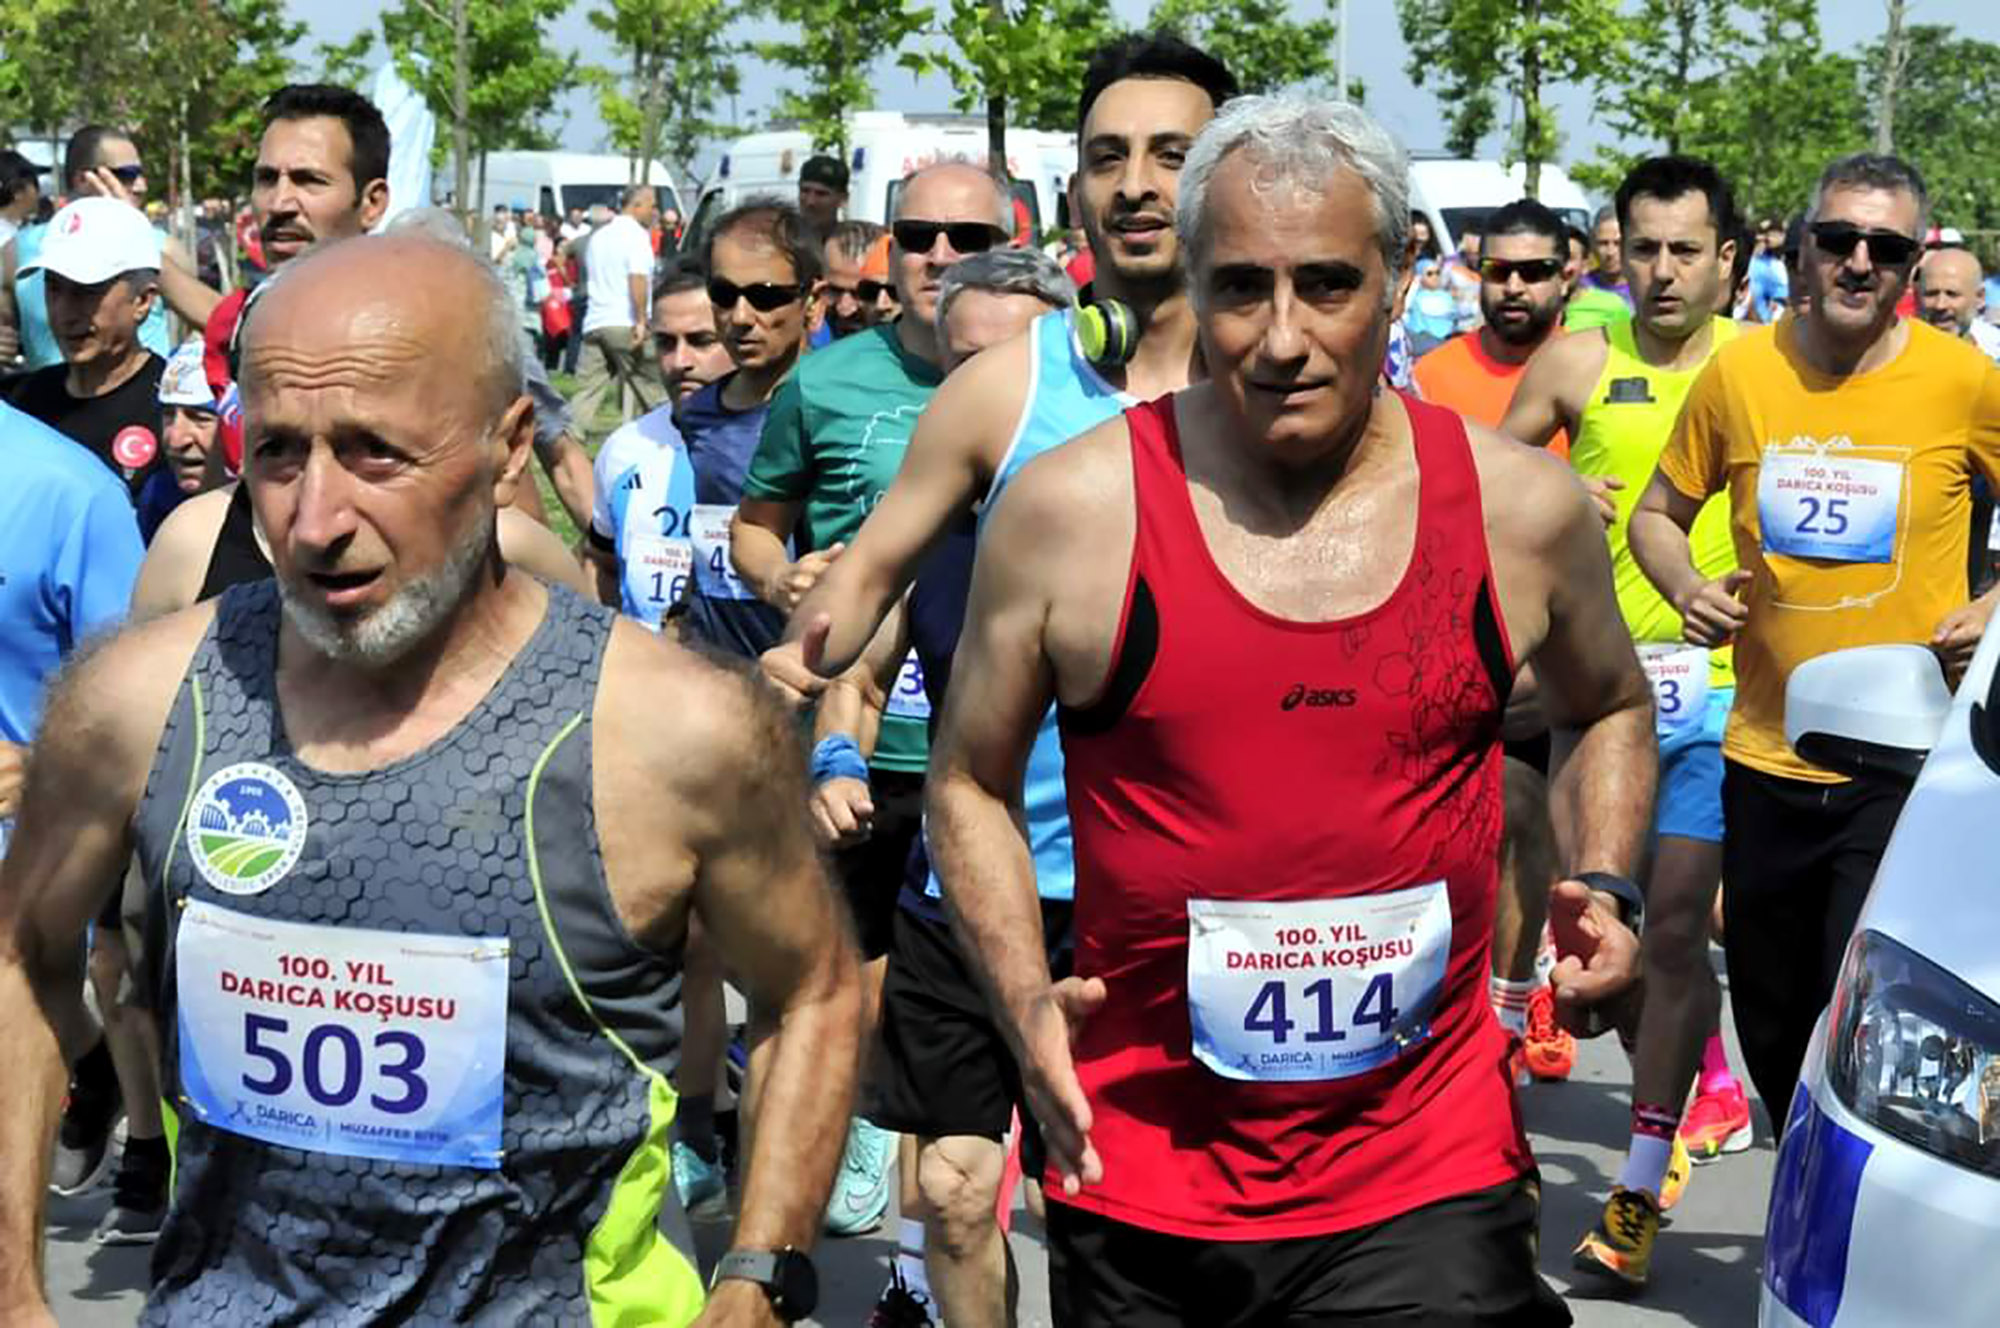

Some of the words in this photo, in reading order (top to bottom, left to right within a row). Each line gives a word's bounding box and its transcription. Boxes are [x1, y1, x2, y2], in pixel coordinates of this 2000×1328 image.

[1795, 496, 1849, 535] 25
[1275, 928, 1324, 946] 100.
[1330, 925, 1368, 943] YIL
[1226, 950, 1315, 970] DARICA
[1322, 938, 1414, 970] KOŞUSU
[278, 955, 337, 982] 100.
[345, 961, 394, 986] YIL
[221, 971, 326, 1009] DARICA
[334, 990, 456, 1022] KOŞUSU
[1244, 972, 1399, 1044] 414
[242, 1012, 429, 1115] 503
[1260, 1052, 1314, 1066] DARICA
[256, 1104, 317, 1129] DARICA
